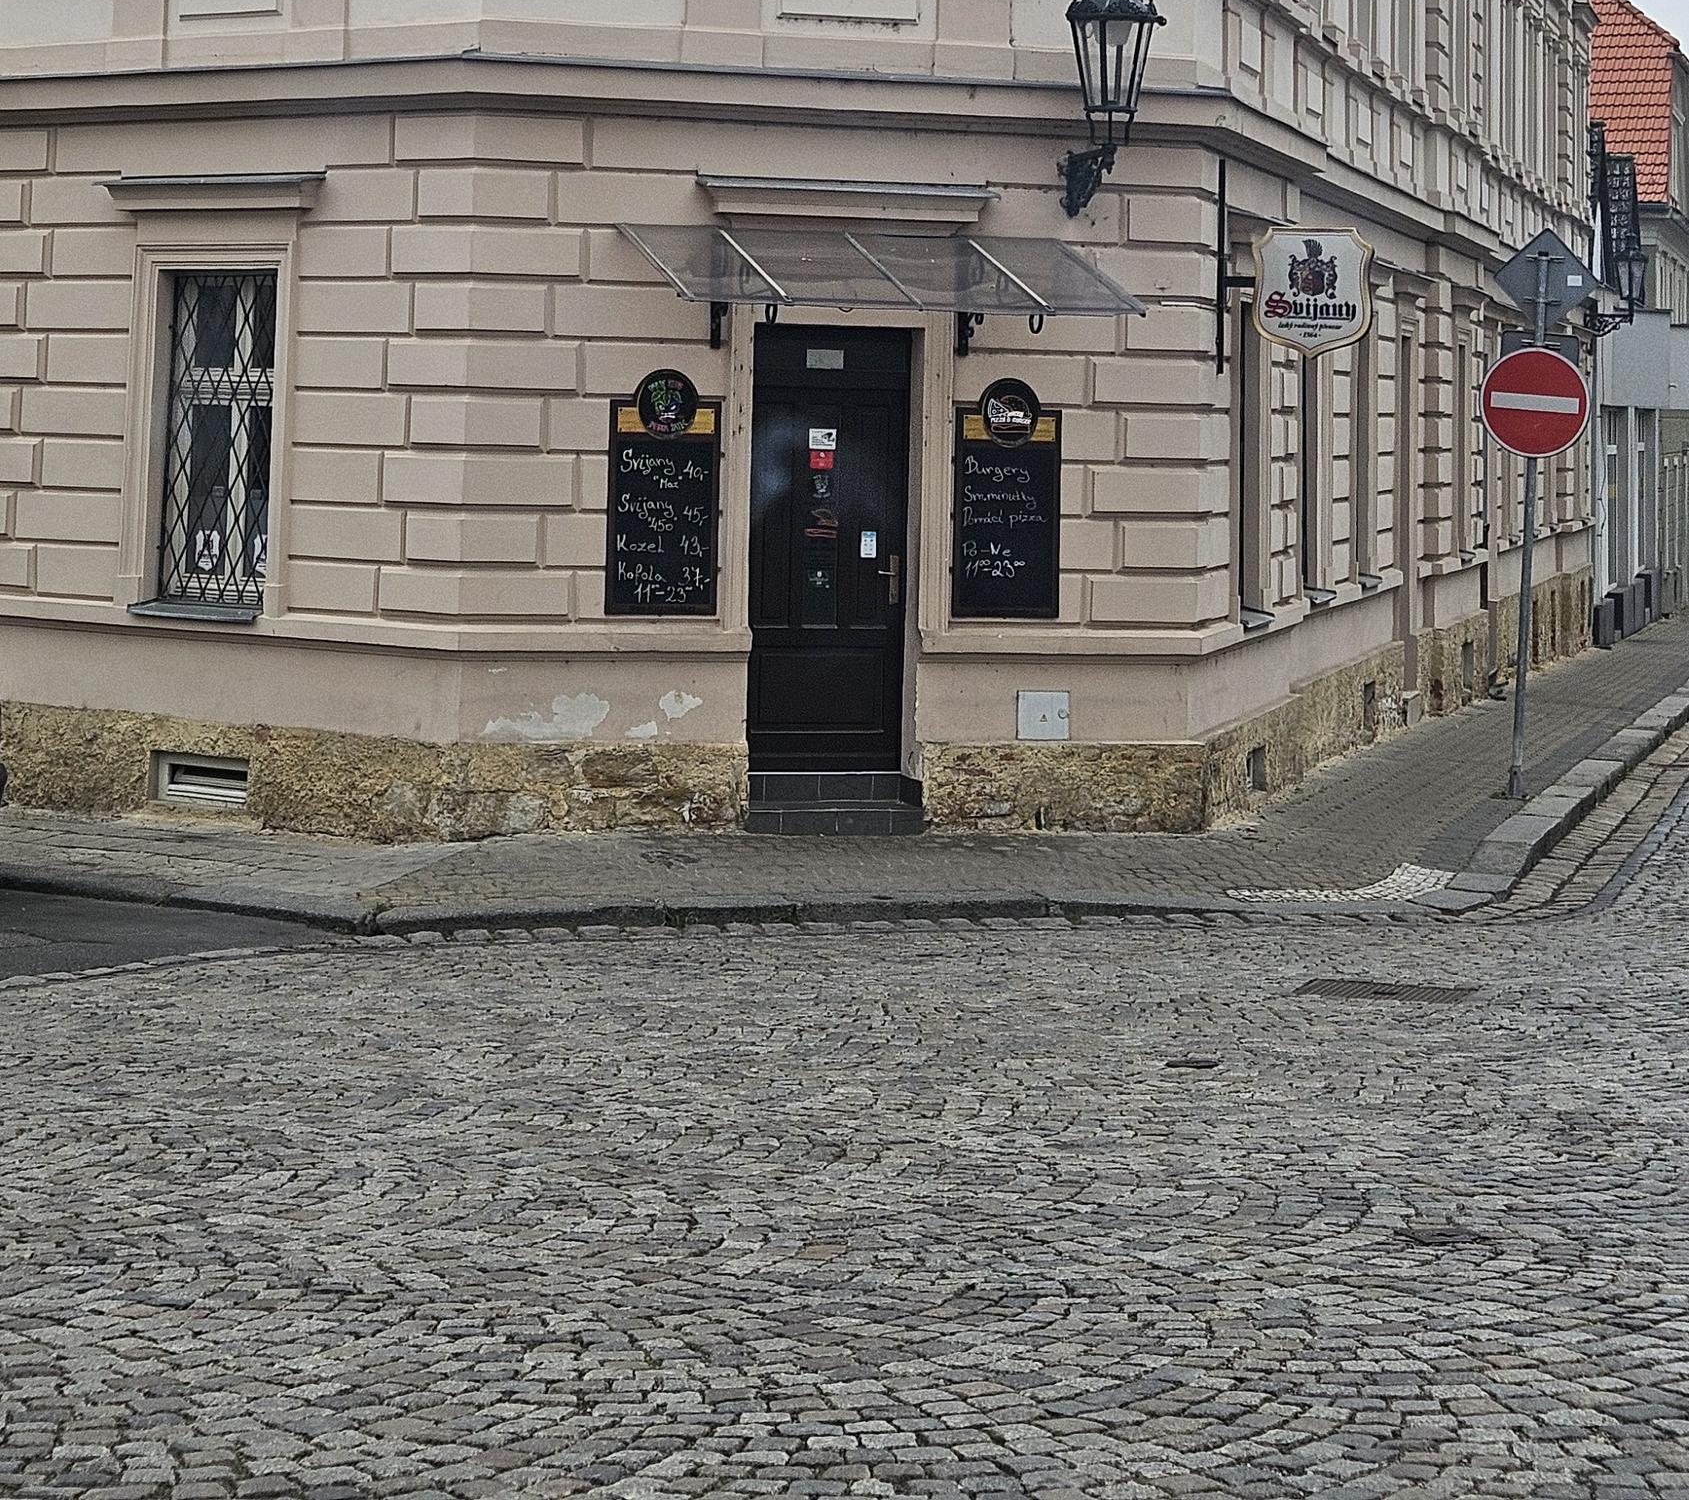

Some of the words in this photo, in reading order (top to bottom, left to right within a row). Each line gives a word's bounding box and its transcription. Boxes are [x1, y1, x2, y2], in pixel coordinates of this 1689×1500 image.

[1264, 291, 1357, 323] Svijany
[620, 448, 676, 476] Svijany
[965, 455, 1030, 484] Burgery
[618, 493, 675, 519] Svijany
[617, 534, 665, 553] Kozel
[618, 561, 667, 586] Kofola
